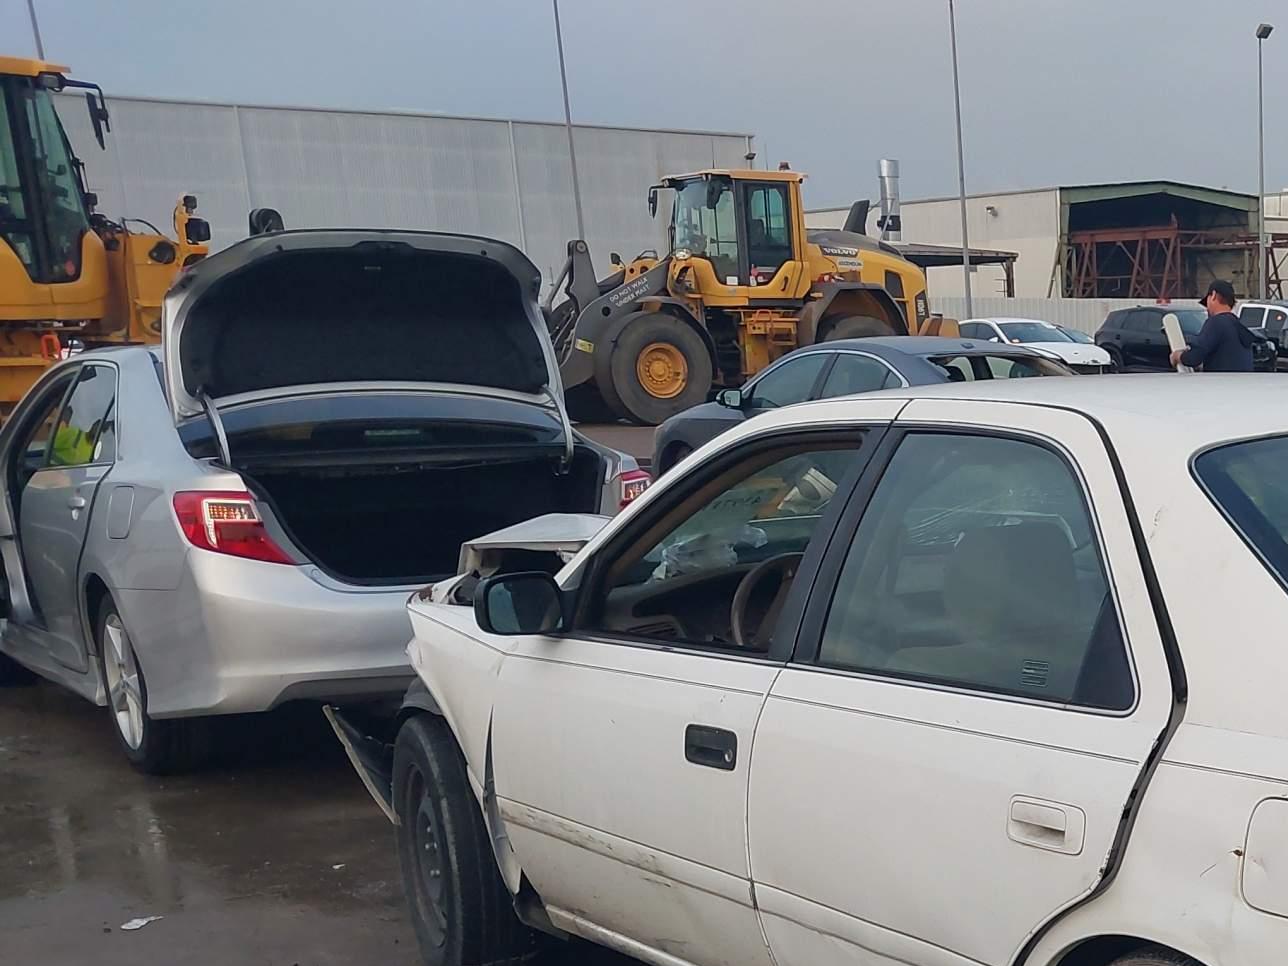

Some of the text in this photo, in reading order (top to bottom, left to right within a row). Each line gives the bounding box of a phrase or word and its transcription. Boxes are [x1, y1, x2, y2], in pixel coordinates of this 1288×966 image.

[823, 247, 858, 256] VOLVO
[609, 277, 648, 303] DO NOT WALK
